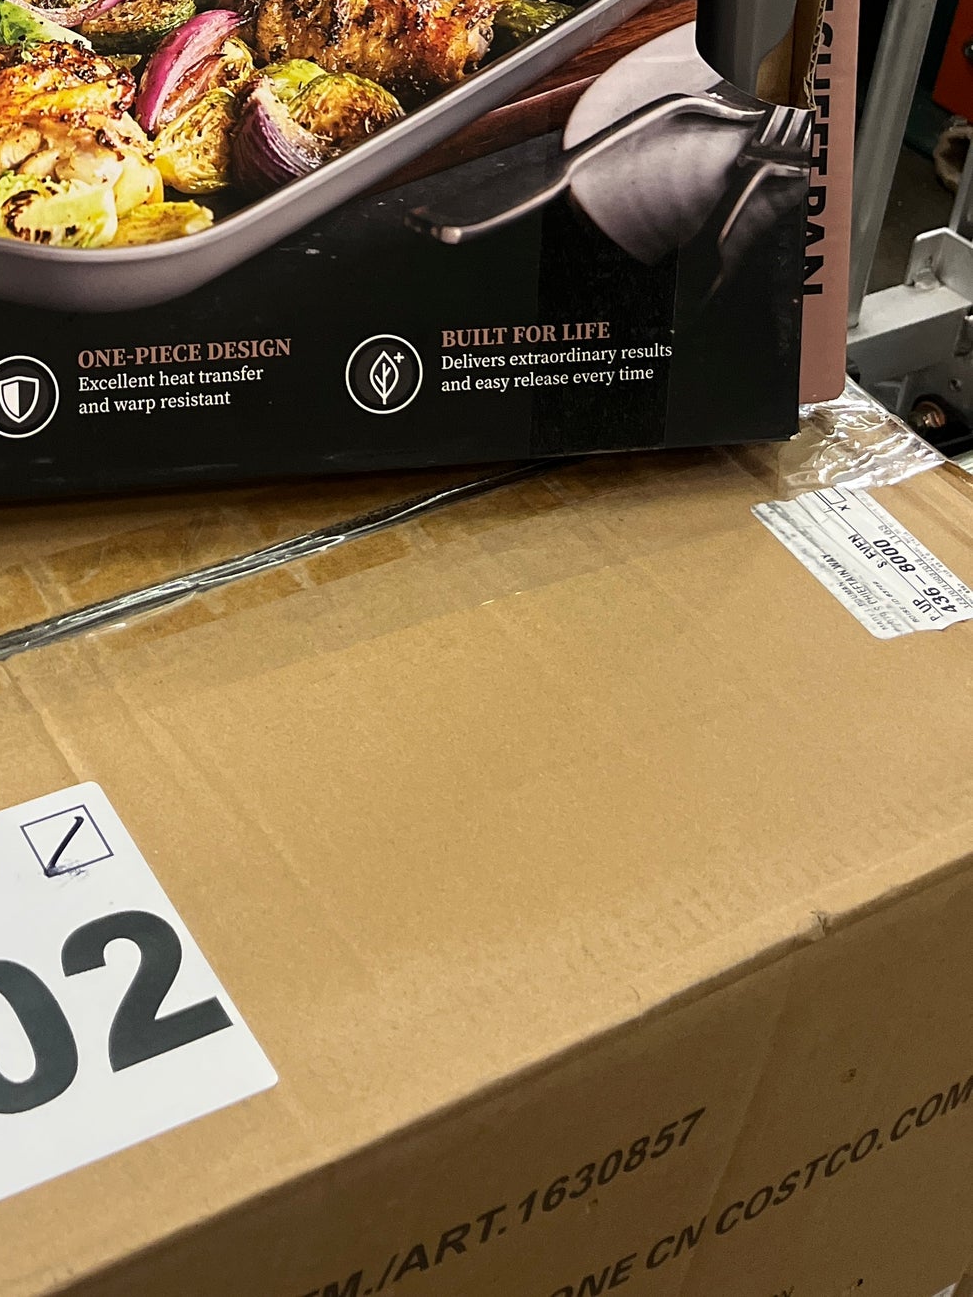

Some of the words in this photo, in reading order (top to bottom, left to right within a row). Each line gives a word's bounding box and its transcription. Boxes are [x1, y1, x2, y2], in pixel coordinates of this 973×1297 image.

[441, 326, 508, 348] BUILT
[512, 324, 556, 344] FOR
[561, 321, 610, 342] LIFE
[78, 343, 202, 368] ONE-PIECE
[207, 338, 291, 360] DESIGN
[441, 352, 507, 371] Delivers
[509, 346, 617, 368] extraordinary
[621, 343, 673, 360] results
[78, 370, 156, 392] Excellent
[159, 369, 195, 387] heat
[198, 364, 264, 384] transfer
[441, 376, 472, 392] and
[474, 375, 511, 393] easy
[513, 370, 569, 389] release
[572, 368, 616, 387] every
[618, 365, 654, 382] time
[78, 397, 111, 414] and
[113, 396, 157, 414] warp
[160, 390, 232, 409] resistant
[848, 534, 875, 559] EVEN
[872, 539, 916, 572] 8000
[912, 598, 932, 614] UP
[923, 587, 958, 613] 436
[646, 1216, 707, 1270] CN
